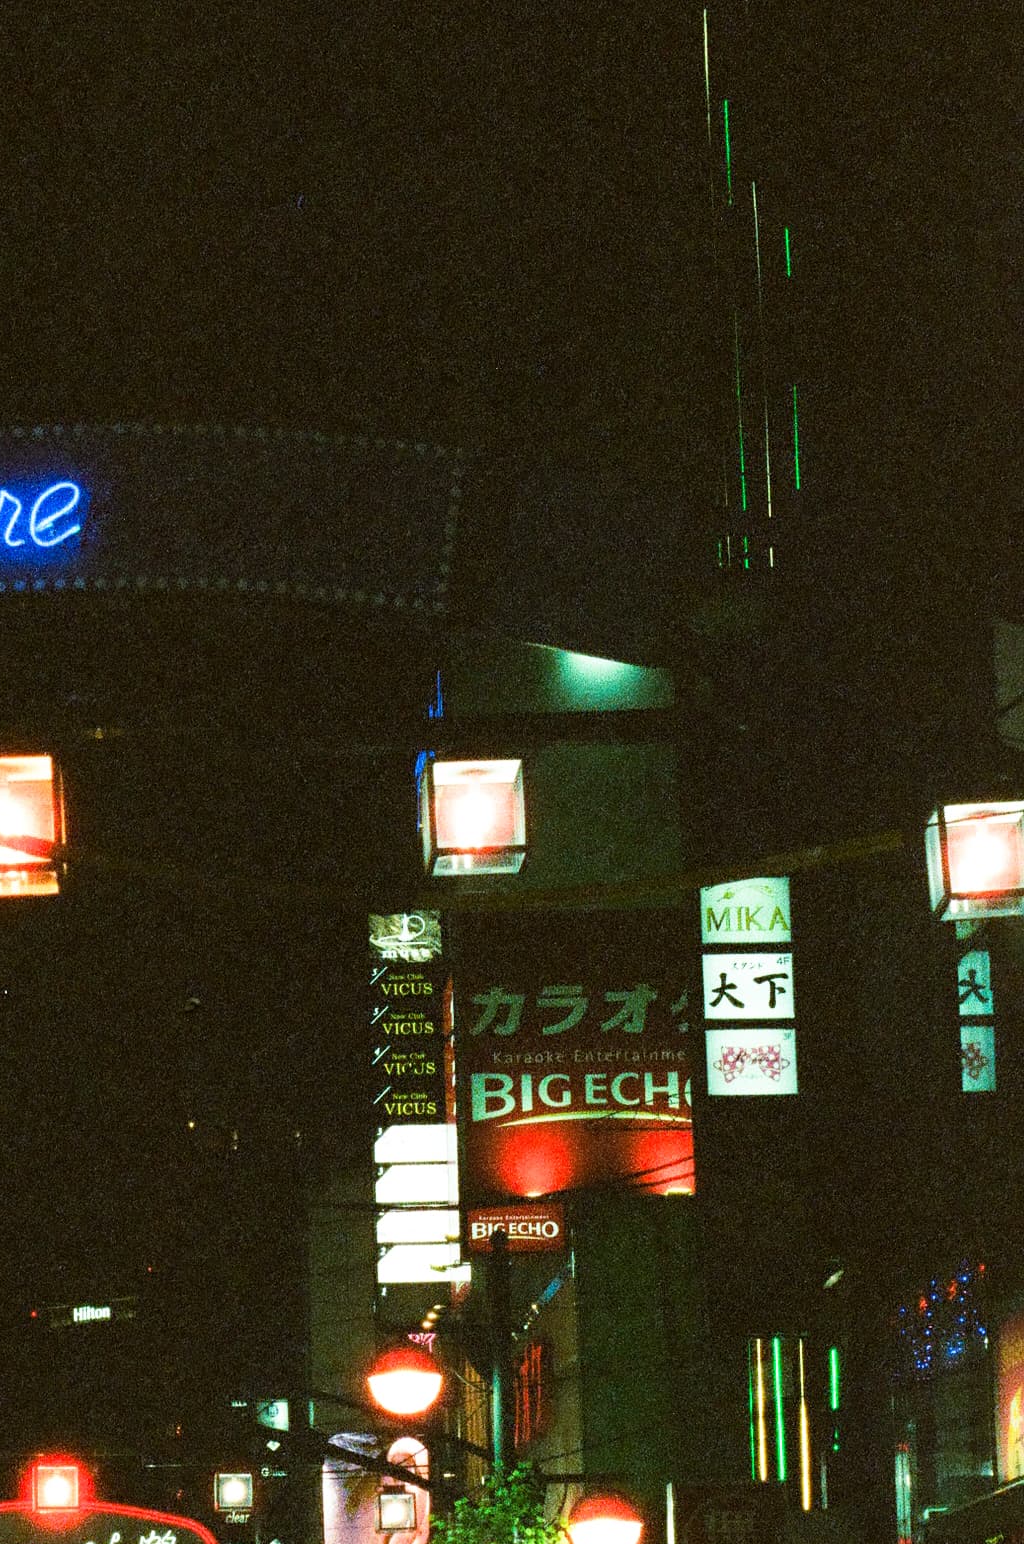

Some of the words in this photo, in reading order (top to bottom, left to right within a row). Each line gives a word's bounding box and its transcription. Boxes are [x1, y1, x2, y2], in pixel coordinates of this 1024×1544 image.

[706, 905, 790, 932] MIKA
[380, 982, 433, 996] VICUS
[709, 972, 789, 1008] 大下
[470, 983, 689, 1036] カラオ
[382, 1022, 435, 1035] VICUS
[492, 1051, 564, 1064] Karaoke
[384, 1062, 437, 1075] VICUS
[471, 1073, 572, 1122] BIG
[385, 1102, 438, 1115] VICUS
[508, 1221, 559, 1239] ECHO
